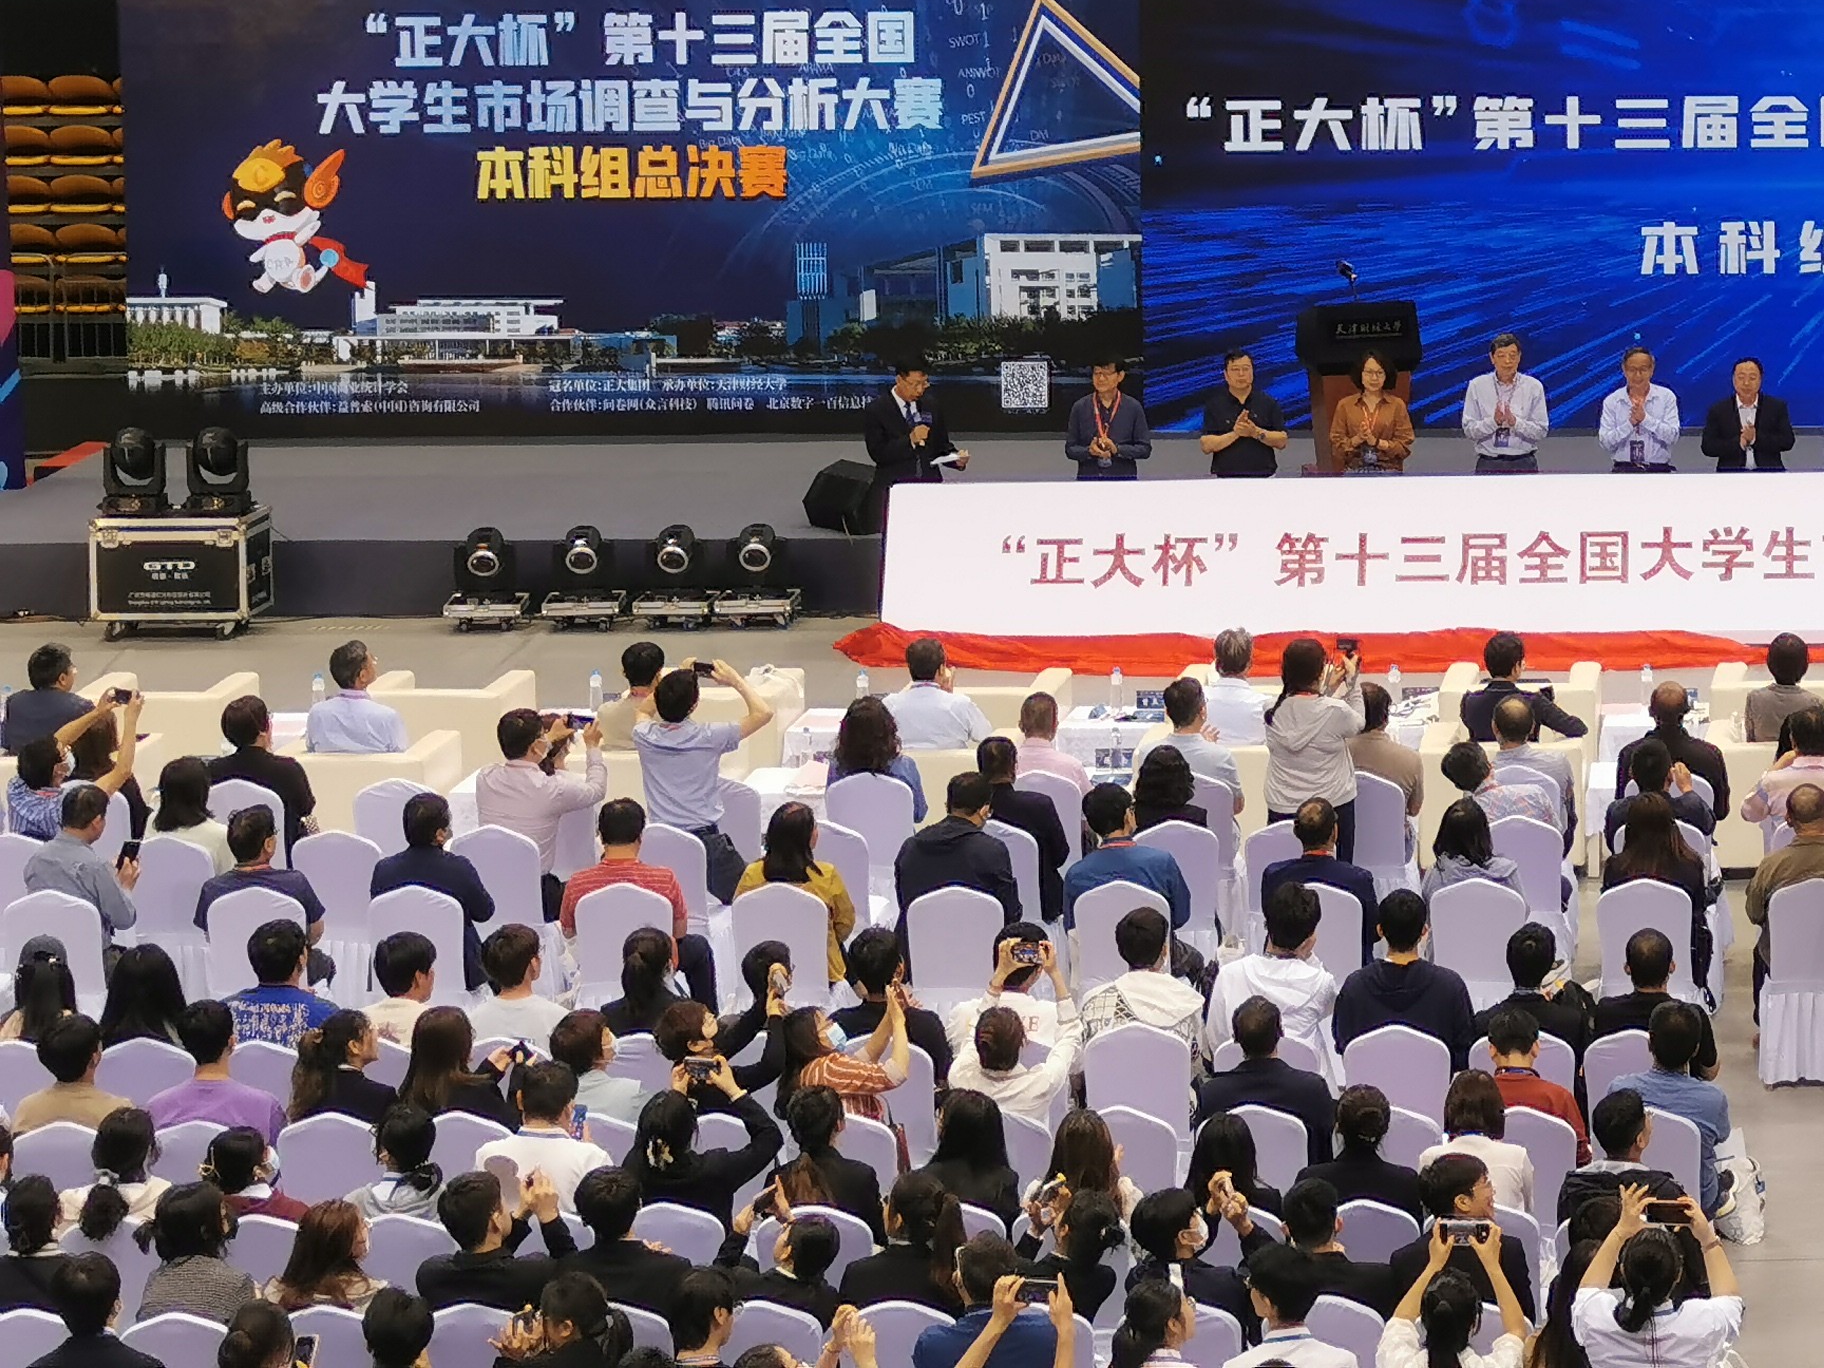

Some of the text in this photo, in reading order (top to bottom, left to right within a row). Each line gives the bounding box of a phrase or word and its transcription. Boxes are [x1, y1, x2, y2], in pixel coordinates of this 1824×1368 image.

[316, 78, 944, 135] 大学生市场调查与分析大赛
[477, 144, 788, 201] 本科组总决赛
[143, 561, 196, 571] GTD
